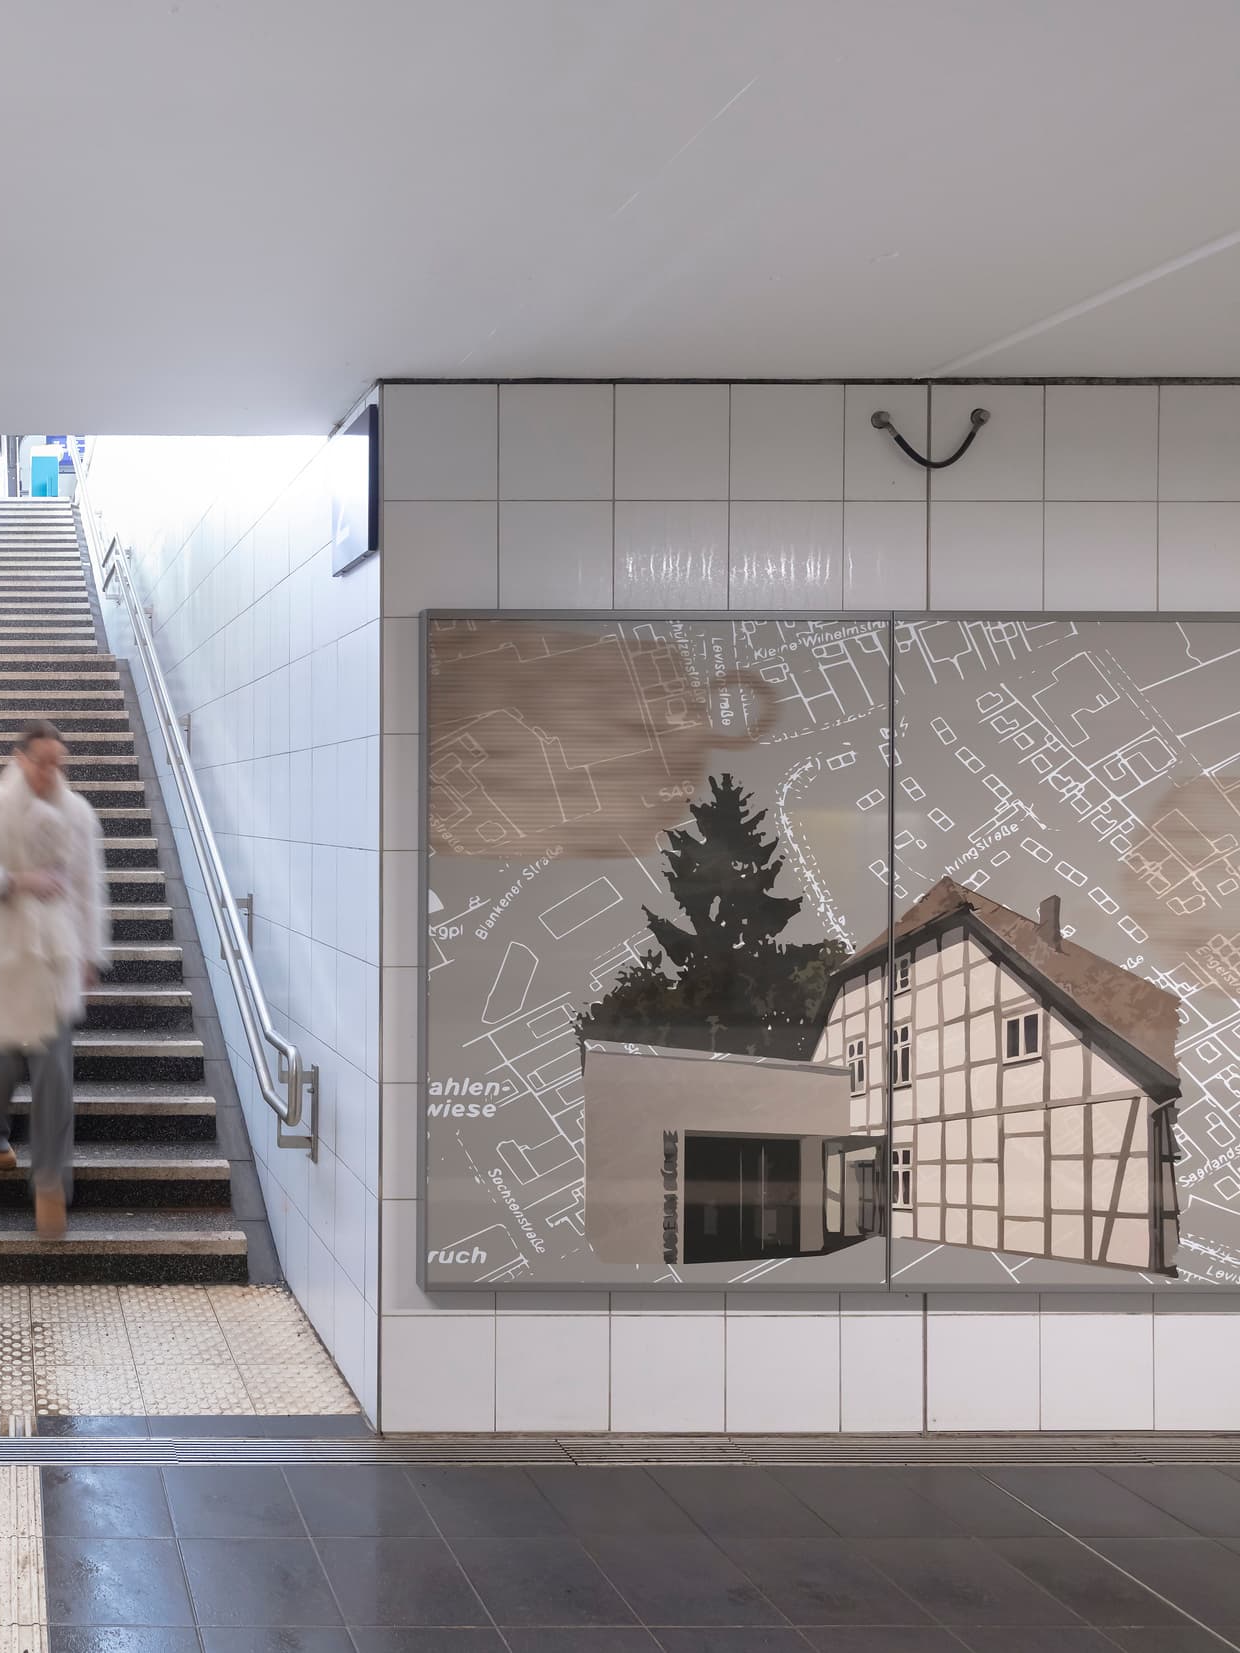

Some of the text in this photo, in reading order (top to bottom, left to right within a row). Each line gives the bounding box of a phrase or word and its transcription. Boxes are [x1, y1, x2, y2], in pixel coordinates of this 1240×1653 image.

[754, 641, 798, 660] Kleine
[475, 879, 523, 940] Blankener
[427, 1076, 510, 1096] ahlen-
[488, 1168, 545, 1254] Sachsenstraße
